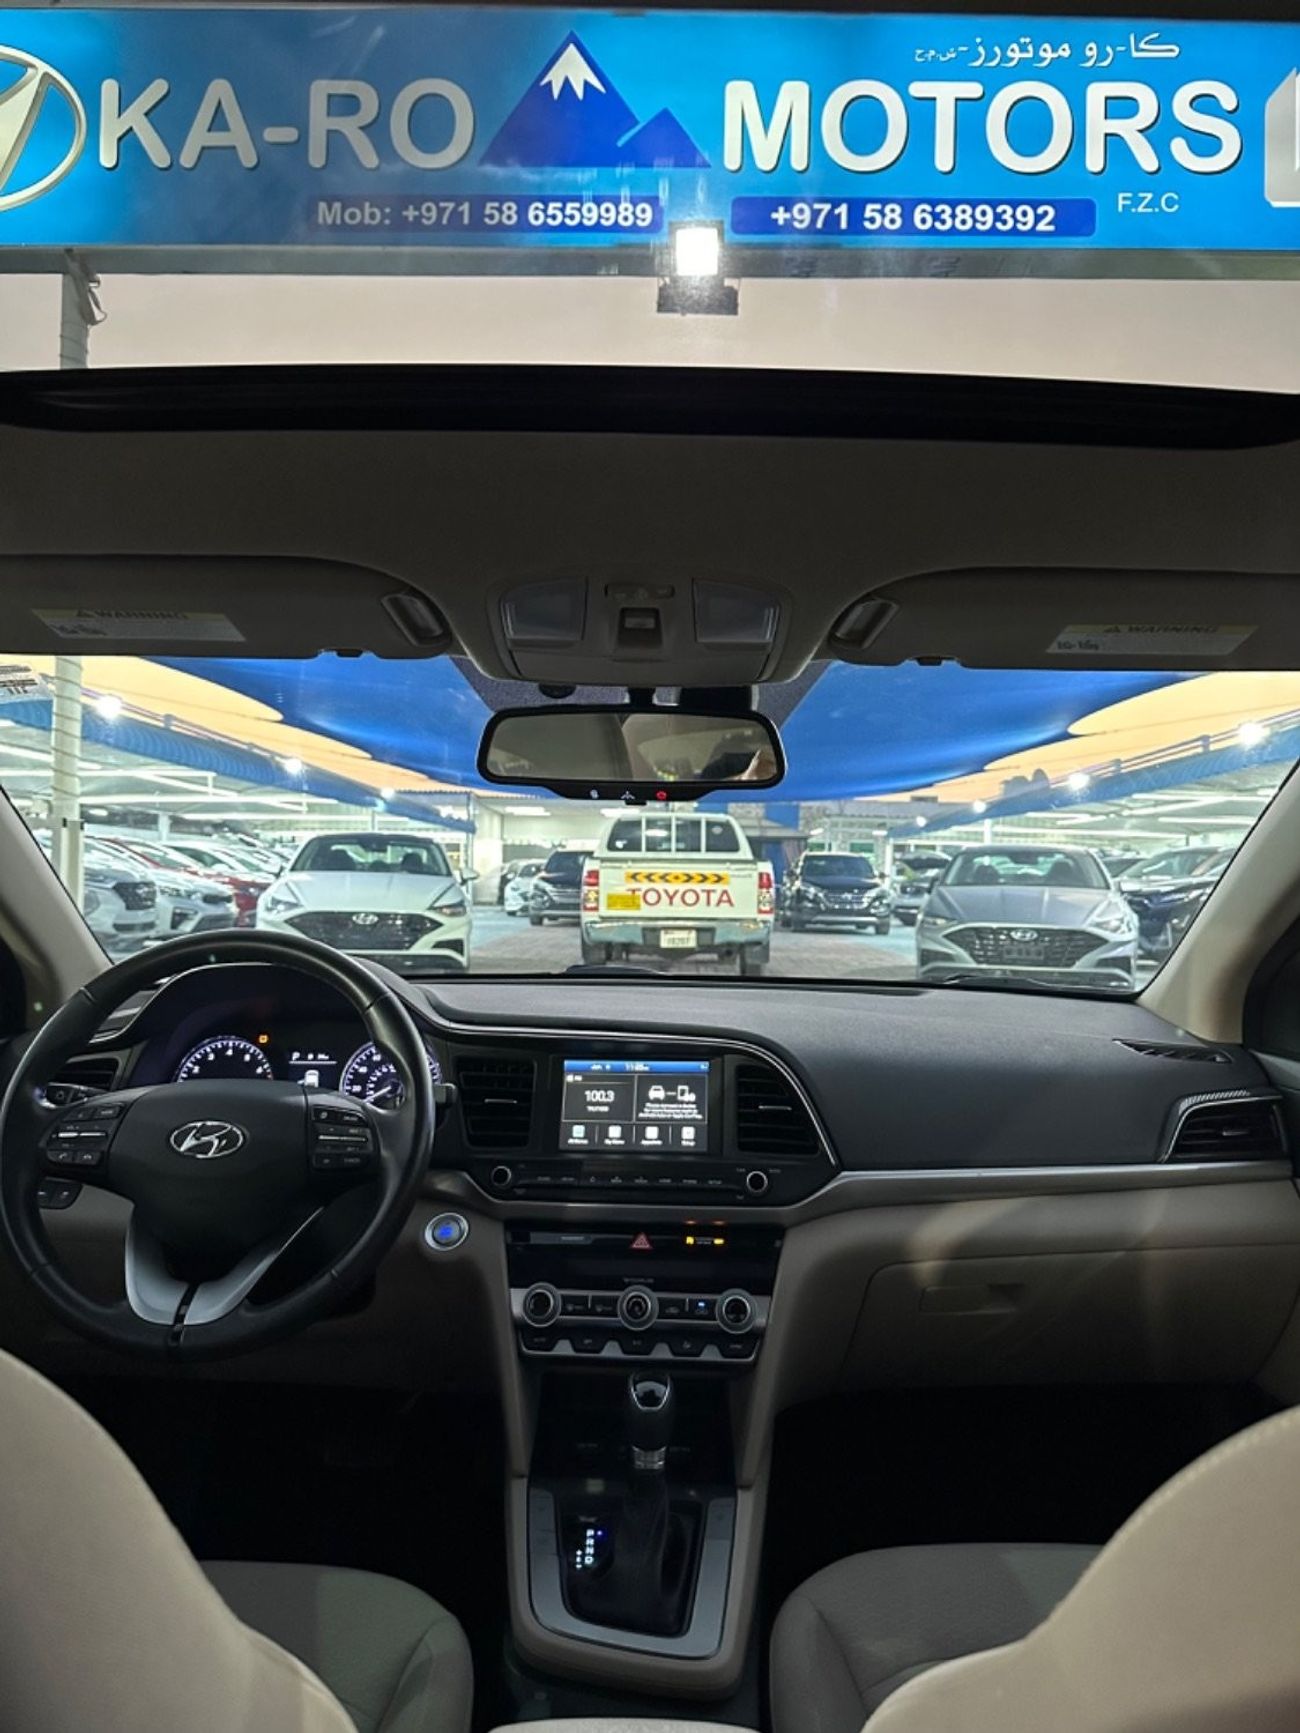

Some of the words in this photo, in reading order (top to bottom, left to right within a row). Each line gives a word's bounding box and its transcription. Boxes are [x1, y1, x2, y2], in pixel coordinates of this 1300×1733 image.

[99, 79, 475, 169] KA-RO
[723, 79, 1243, 174] MOTORS
[318, 200, 392, 227] Mob:
[402, 201, 470, 227] +971
[483, 202, 519, 228] 58
[527, 201, 654, 229] 6559989
[770, 202, 848, 230] +971
[863, 203, 903, 231] 58
[912, 203, 1056, 232] 6389392
[1116, 191, 1180, 214] F.Z.C
[626, 887, 735, 907] TOYOTA
